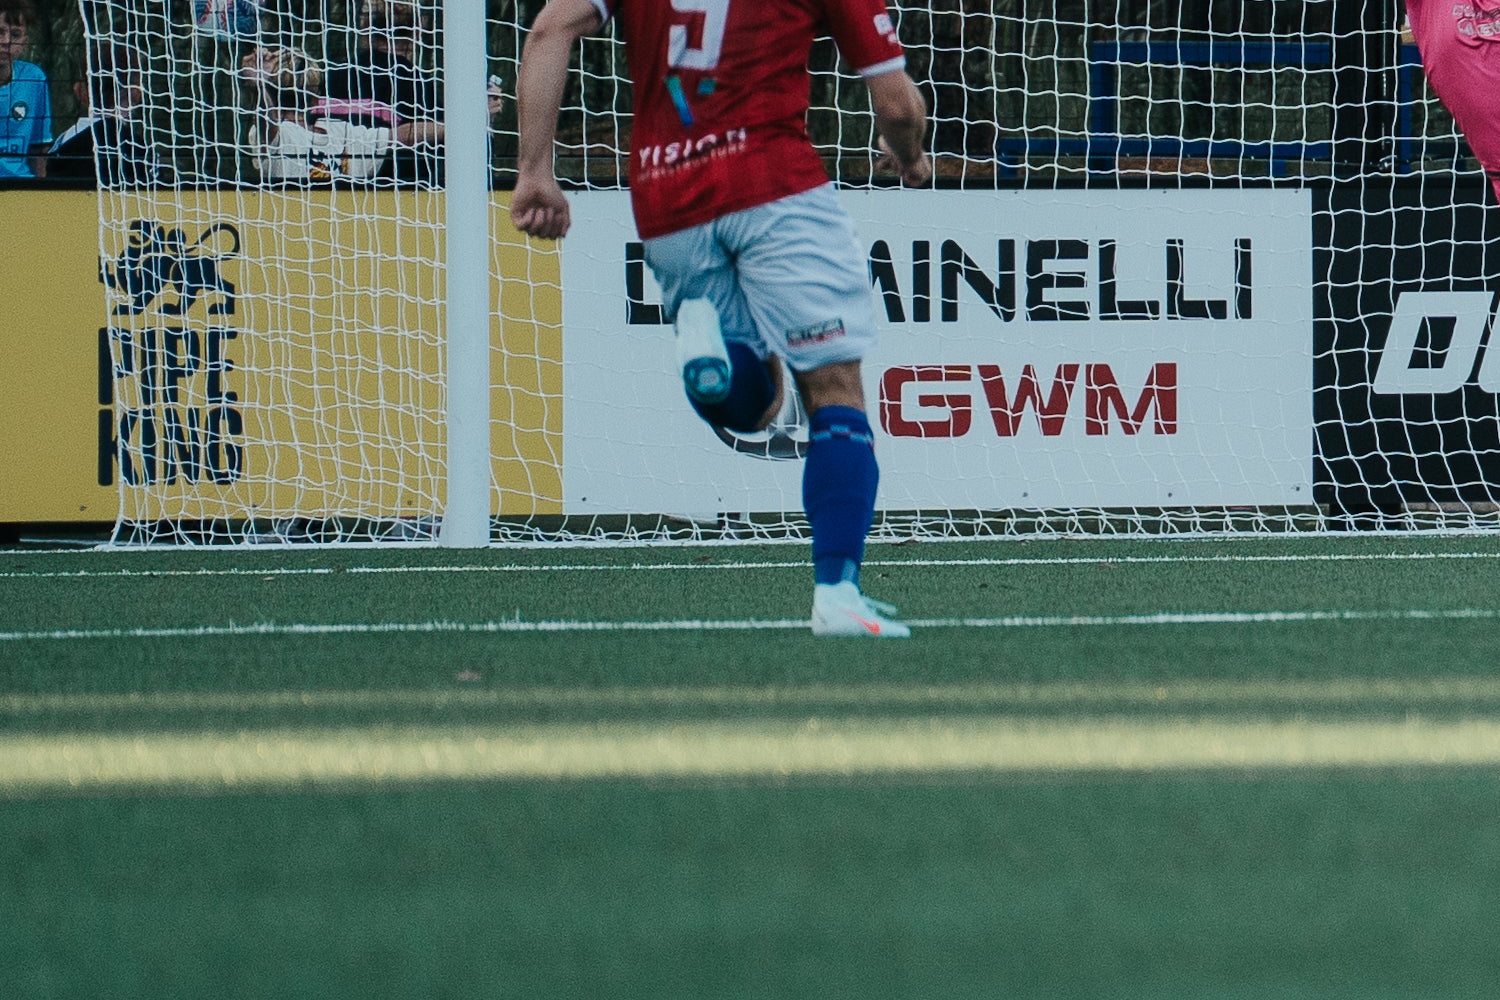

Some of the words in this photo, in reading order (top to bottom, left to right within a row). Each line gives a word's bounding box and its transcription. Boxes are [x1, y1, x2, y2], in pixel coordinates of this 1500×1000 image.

[98, 327, 238, 406] PIPE
[879, 362, 1178, 438] GWM
[98, 407, 243, 487] KING
